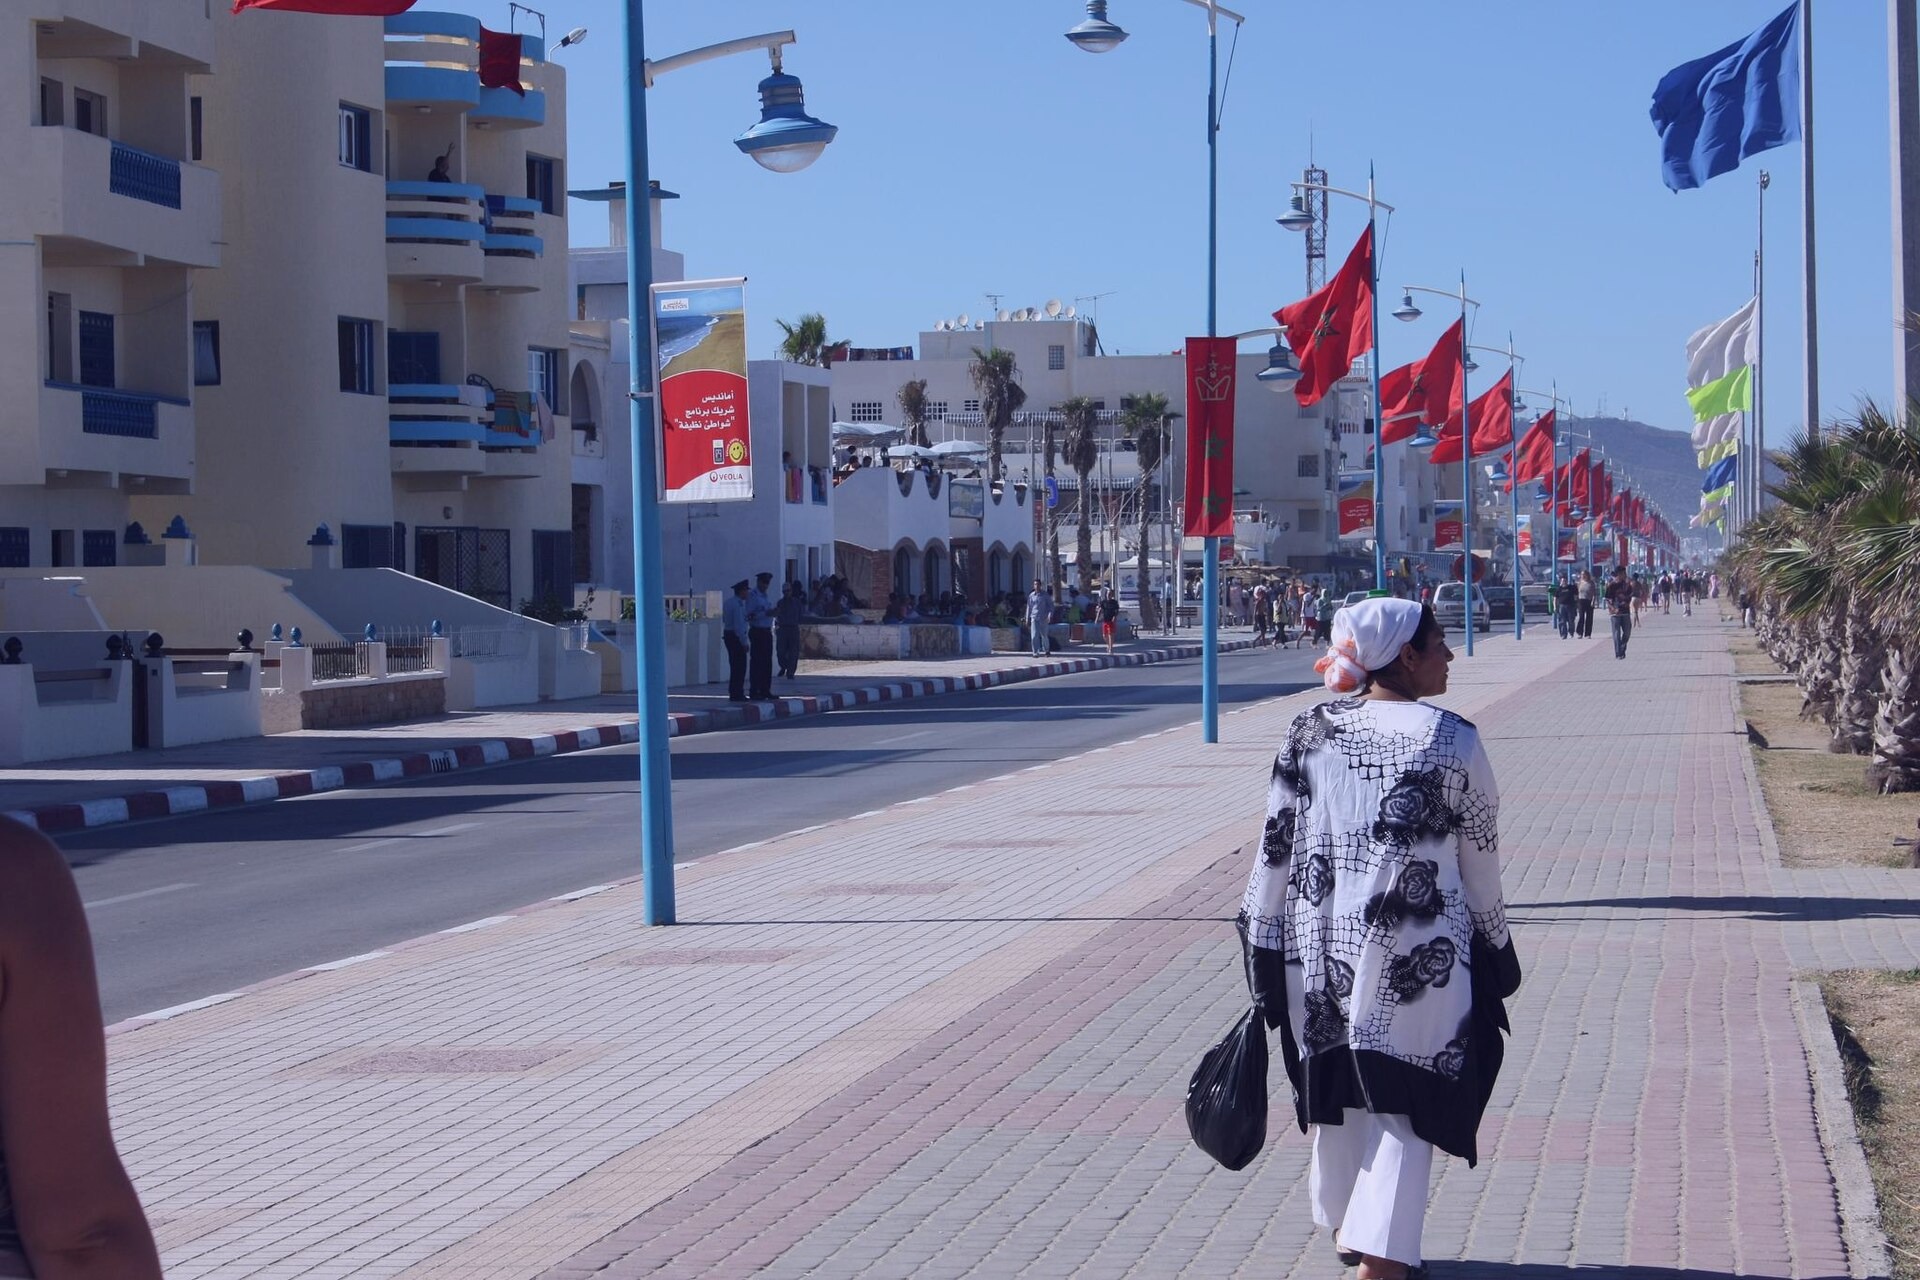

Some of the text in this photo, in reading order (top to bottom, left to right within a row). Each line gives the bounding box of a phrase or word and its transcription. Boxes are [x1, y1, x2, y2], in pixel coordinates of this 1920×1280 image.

[685, 405, 735, 418] شريك برنامج
[719, 473, 744, 481] VEOLIA
